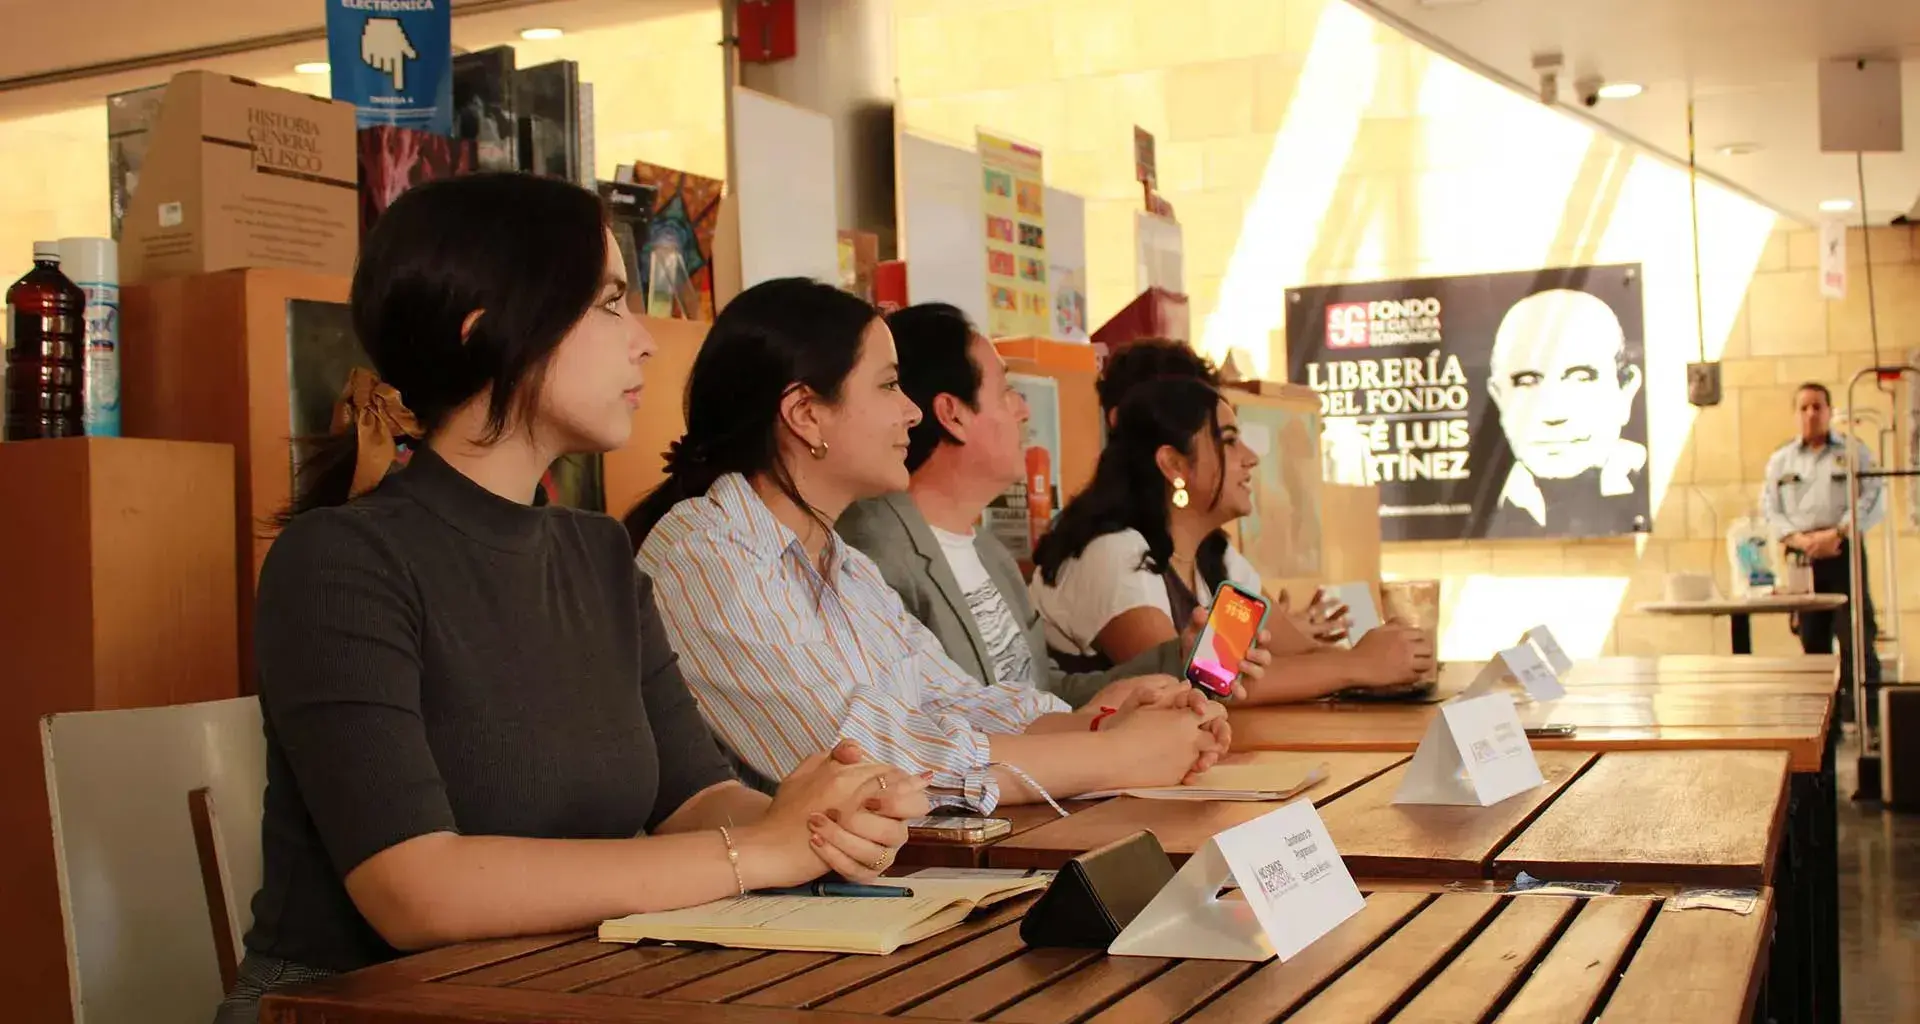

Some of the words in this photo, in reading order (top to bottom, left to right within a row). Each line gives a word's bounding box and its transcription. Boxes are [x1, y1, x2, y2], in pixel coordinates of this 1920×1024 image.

[247, 107, 320, 136] HISTORIA
[247, 126, 324, 153] GENERAL
[250, 146, 322, 173] JALISCO
[1368, 297, 1441, 320] FONDO
[1306, 349, 1467, 391] LIBRERÍA
[1366, 385, 1469, 414] FONDO
[1396, 419, 1470, 449] LUIS
